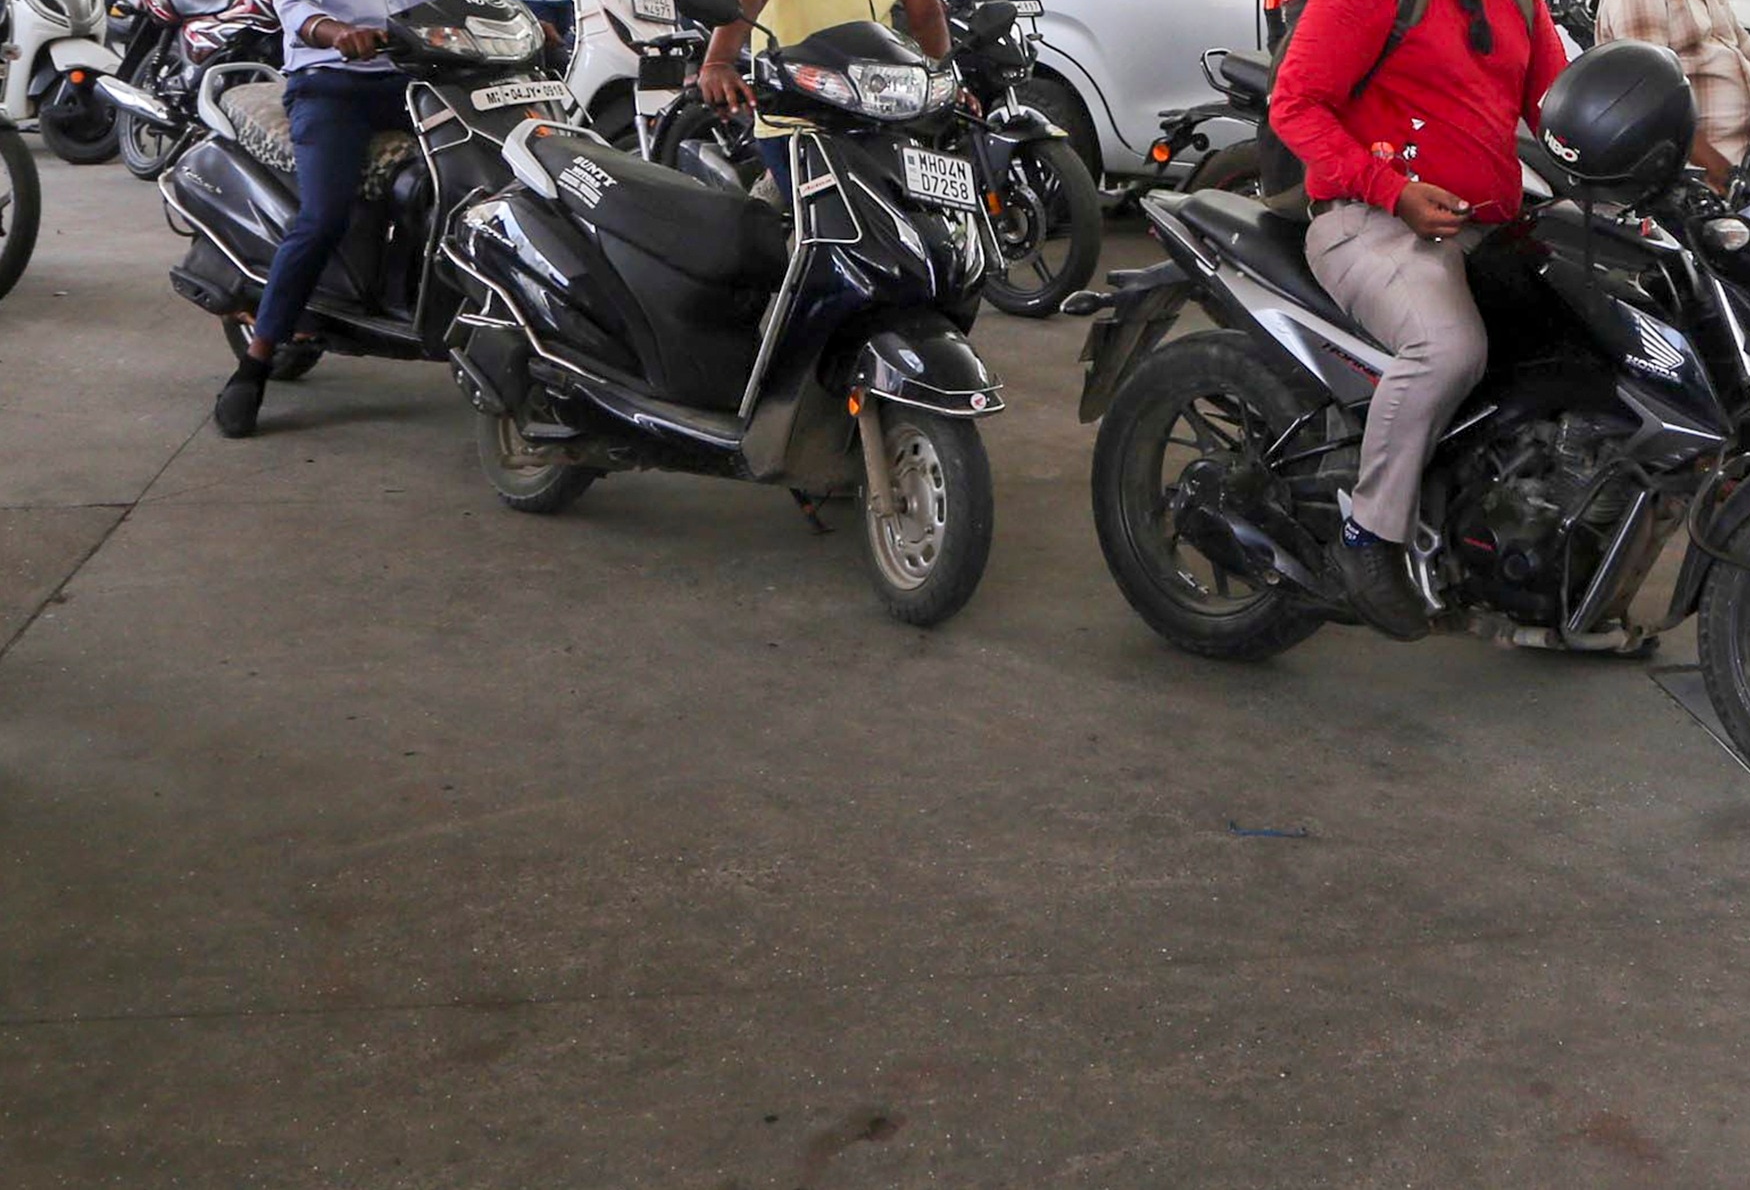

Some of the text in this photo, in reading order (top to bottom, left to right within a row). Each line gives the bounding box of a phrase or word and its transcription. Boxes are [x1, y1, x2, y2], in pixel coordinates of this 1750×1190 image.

[573, 155, 618, 187] BUNTY
[918, 152, 966, 180] MH04N
[921, 173, 969, 201] D7258
